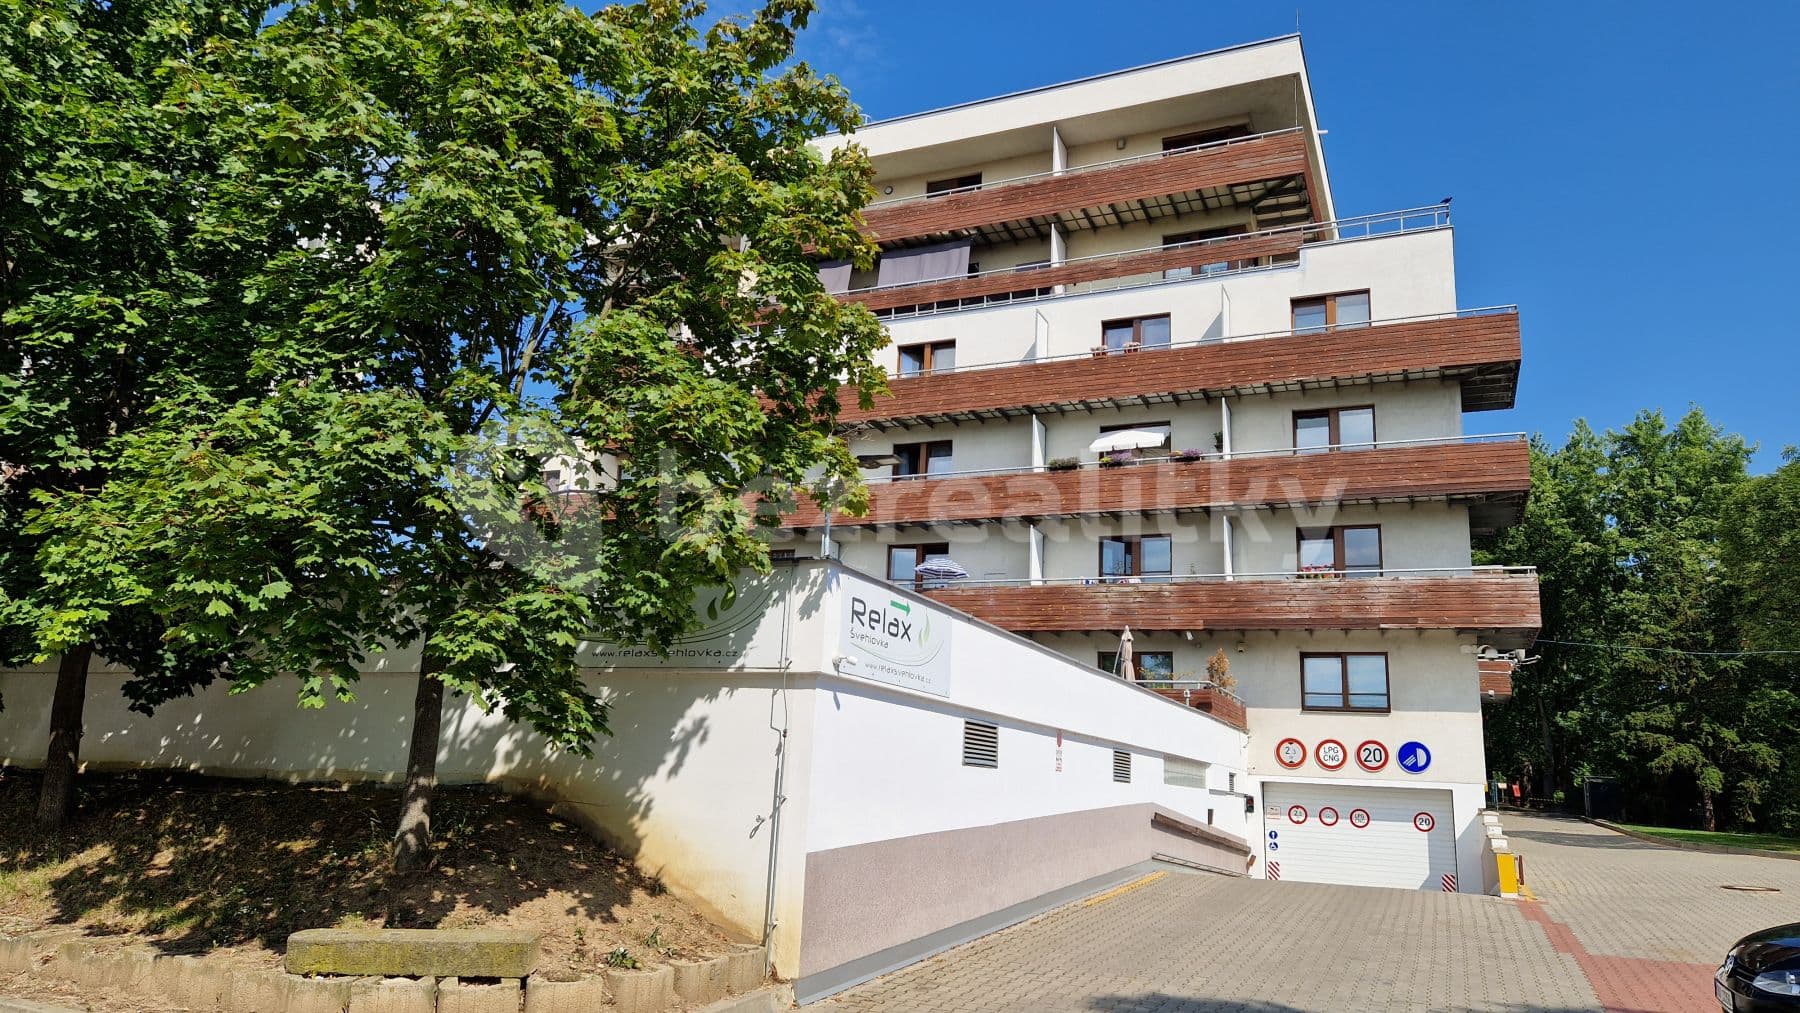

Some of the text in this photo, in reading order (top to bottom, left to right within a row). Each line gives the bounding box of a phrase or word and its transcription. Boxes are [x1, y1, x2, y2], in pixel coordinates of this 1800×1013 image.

[851, 597, 911, 642] Relax
[850, 627, 889, 649] Švehlovka
[591, 648, 738, 657] www.relaxsehlovka.cz
[1323, 746, 1339, 754] LPG
[1323, 754, 1340, 762] CNG
[1363, 747, 1383, 763] 20
[1418, 817, 1431, 826] 20
